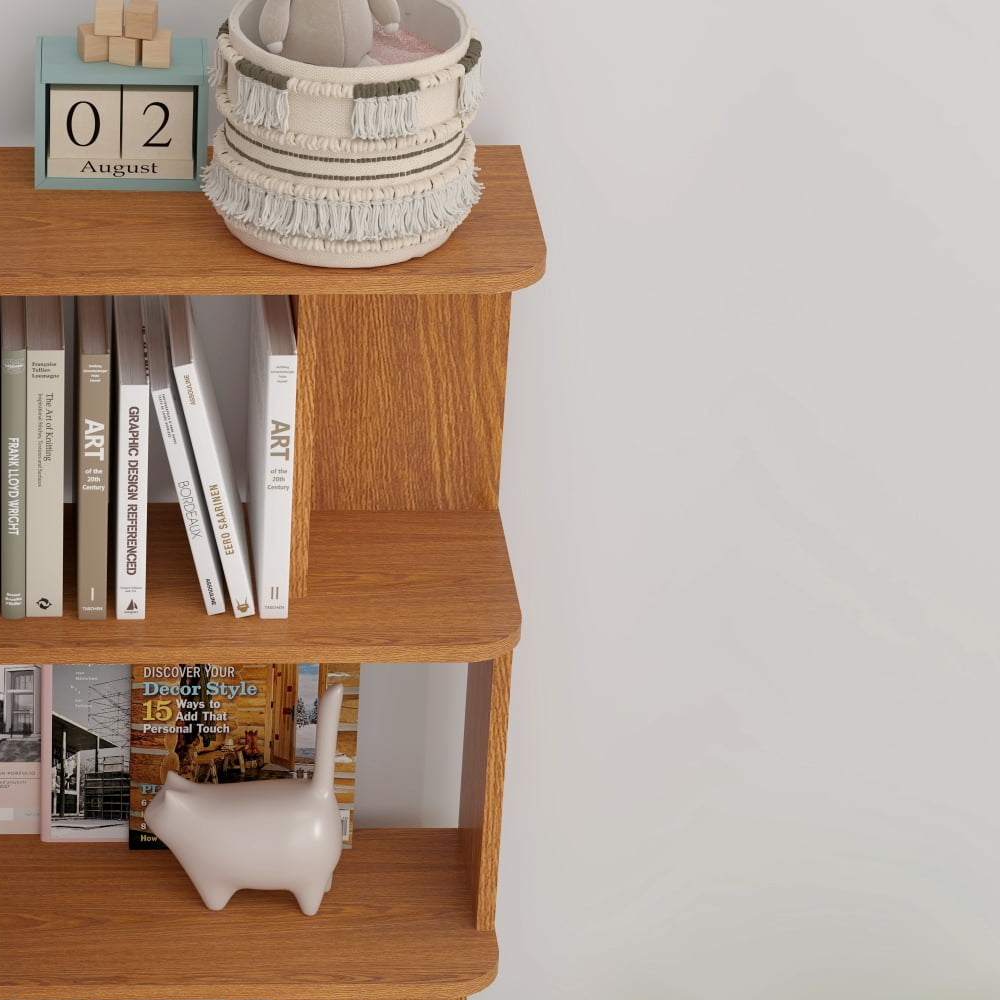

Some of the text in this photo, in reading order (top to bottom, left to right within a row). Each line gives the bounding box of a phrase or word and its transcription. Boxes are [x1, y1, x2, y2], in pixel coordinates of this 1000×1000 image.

[80, 160, 158, 177] August
[45, 393, 54, 407] The
[184, 374, 197, 406] ASSOULINE
[45, 408, 54, 422] Art
[85, 419, 104, 461] ART
[128, 406, 139, 456] GRAPHIC
[270, 419, 291, 461] ART
[43, 431, 54, 461] Knitting
[8, 437, 19, 535] FRANK LLOYD WRIGHT
[82, 484, 105, 492] Century
[127, 460, 138, 500] DESIGN
[267, 484, 290, 492] Century
[177, 480, 202, 540] BORDEAUX
[209, 484, 234, 556] EERO SAARINEN
[126, 504, 138, 575] REFERENCED
[206, 579, 217, 606] ASSOULINE
[143, 666, 235, 678] DISCOVER YOUR
[142, 681, 258, 699] Decor Style
[142, 699, 221, 721] 15 Ways to
[175, 711, 227, 721] Add That
[143, 723, 230, 734] Personal Touch
[140, 834, 158, 842] How
